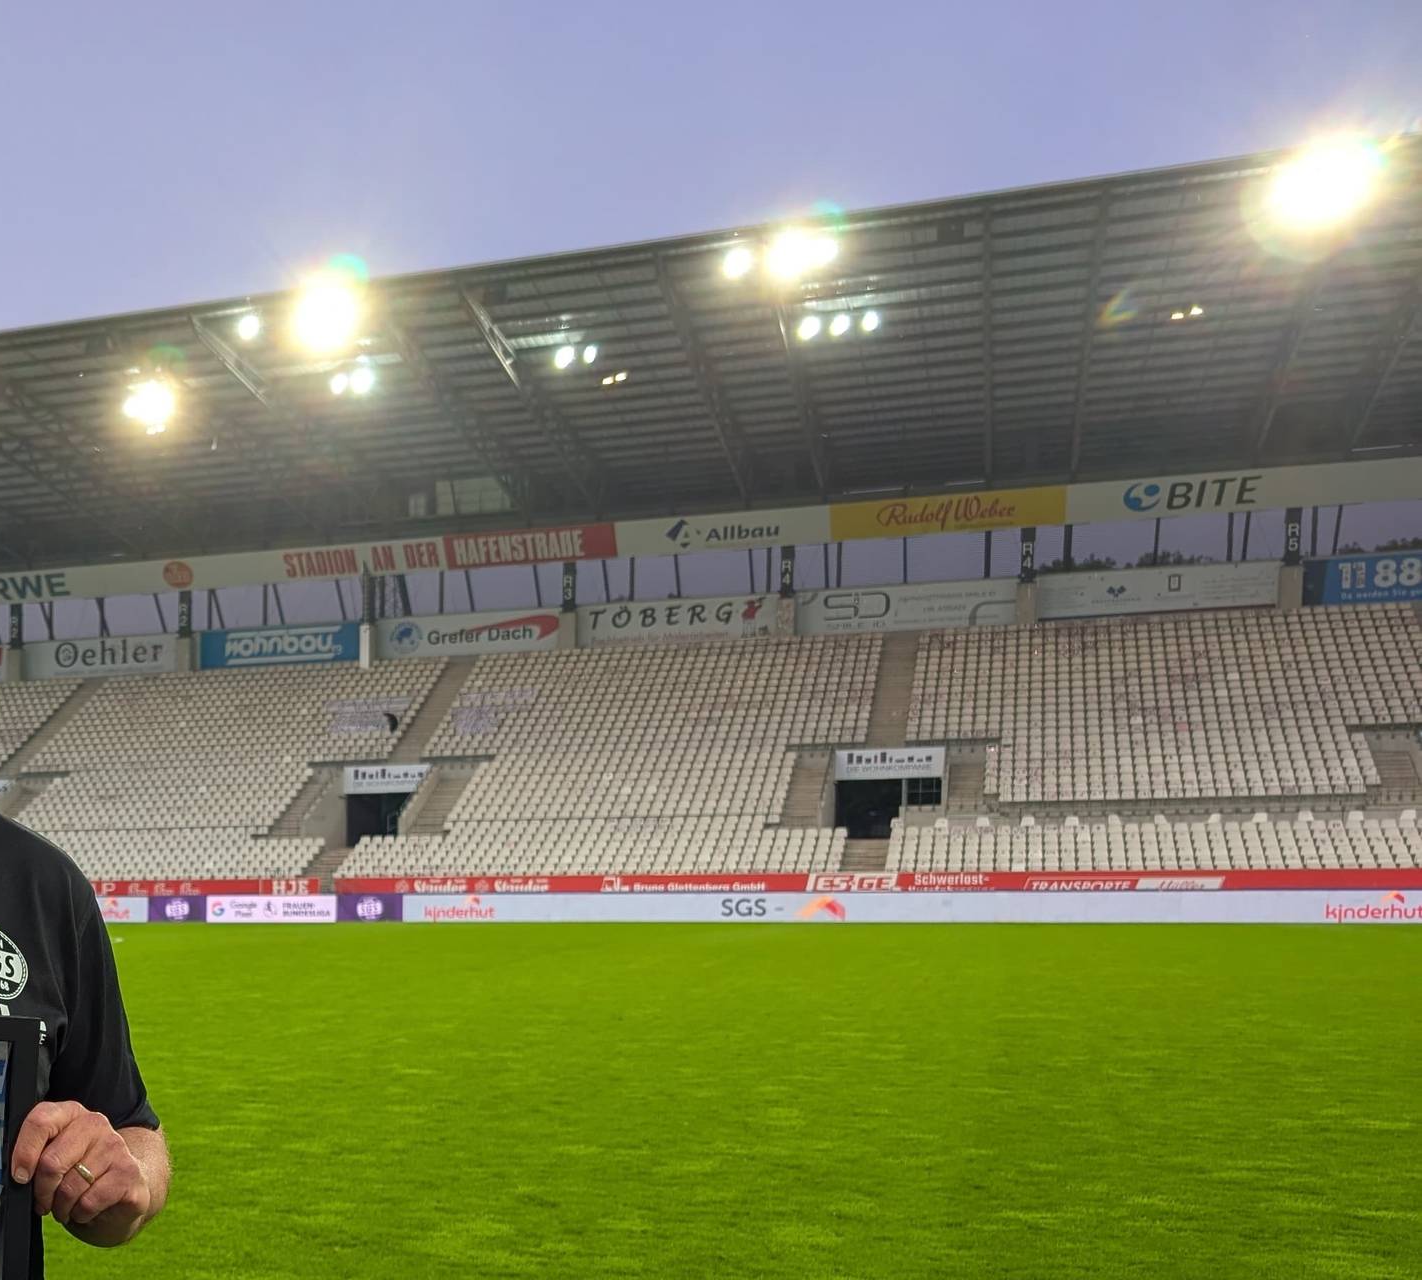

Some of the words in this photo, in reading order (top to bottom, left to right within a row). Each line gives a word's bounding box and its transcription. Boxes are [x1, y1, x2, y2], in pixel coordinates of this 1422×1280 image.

[1166, 475, 1263, 511] BITE
[877, 499, 953, 530] Rudolf
[954, 496, 1015, 521] Weber
[705, 525, 780, 542] Allbau
[283, 549, 359, 578] STADION
[371, 545, 397, 572] AN
[403, 543, 440, 570] DER
[589, 601, 734, 631] TÖBERG
[487, 624, 533, 642] Dach
[54, 638, 163, 668] Oehler
[272, 879, 310, 896] HJE
[633, 882, 665, 892] Bruno
[732, 881, 766, 892] GmbH
[424, 906, 496, 923] kinderhut
[721, 899, 767, 917] SGS
[1326, 899, 1422, 923] kinderhut
